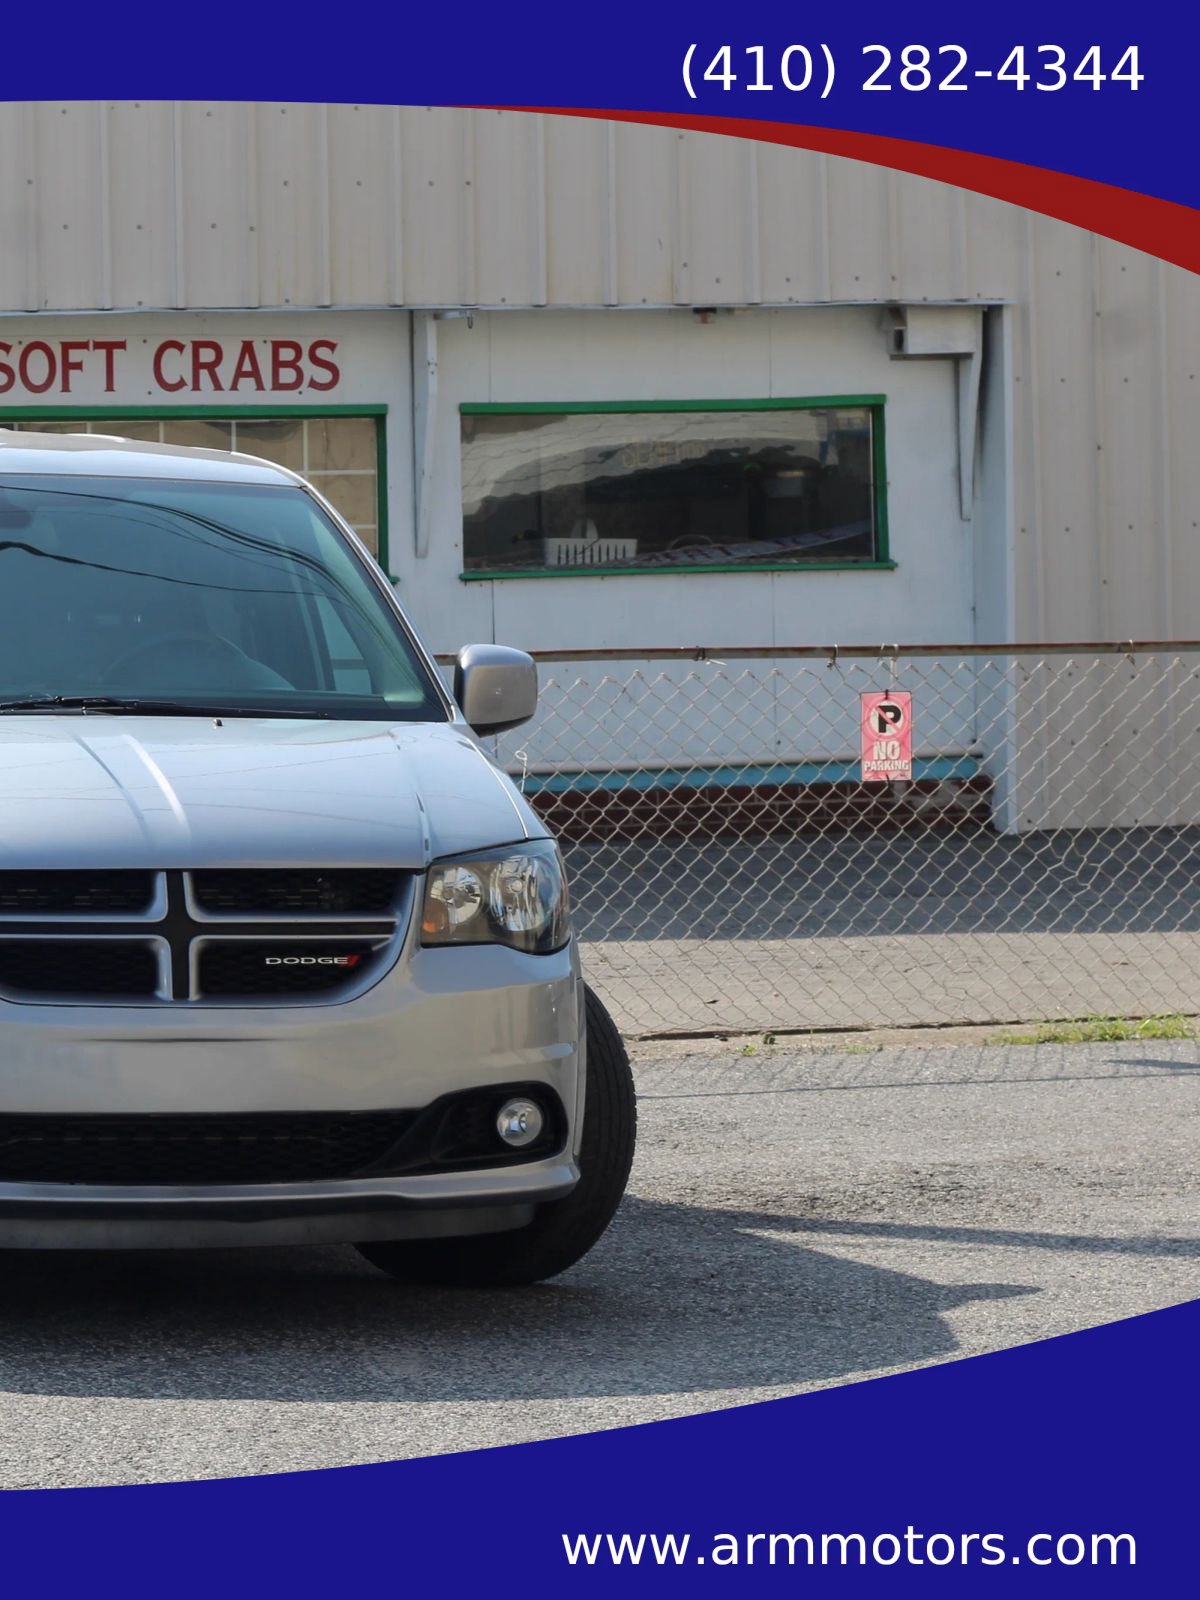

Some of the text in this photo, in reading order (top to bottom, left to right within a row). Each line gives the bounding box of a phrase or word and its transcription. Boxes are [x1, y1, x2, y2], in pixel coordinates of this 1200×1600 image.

[153, 339, 341, 393] CRABS
[873, 741, 901, 760] NO
[864, 760, 910, 771] PARKING
[265, 957, 349, 965] DODGE
